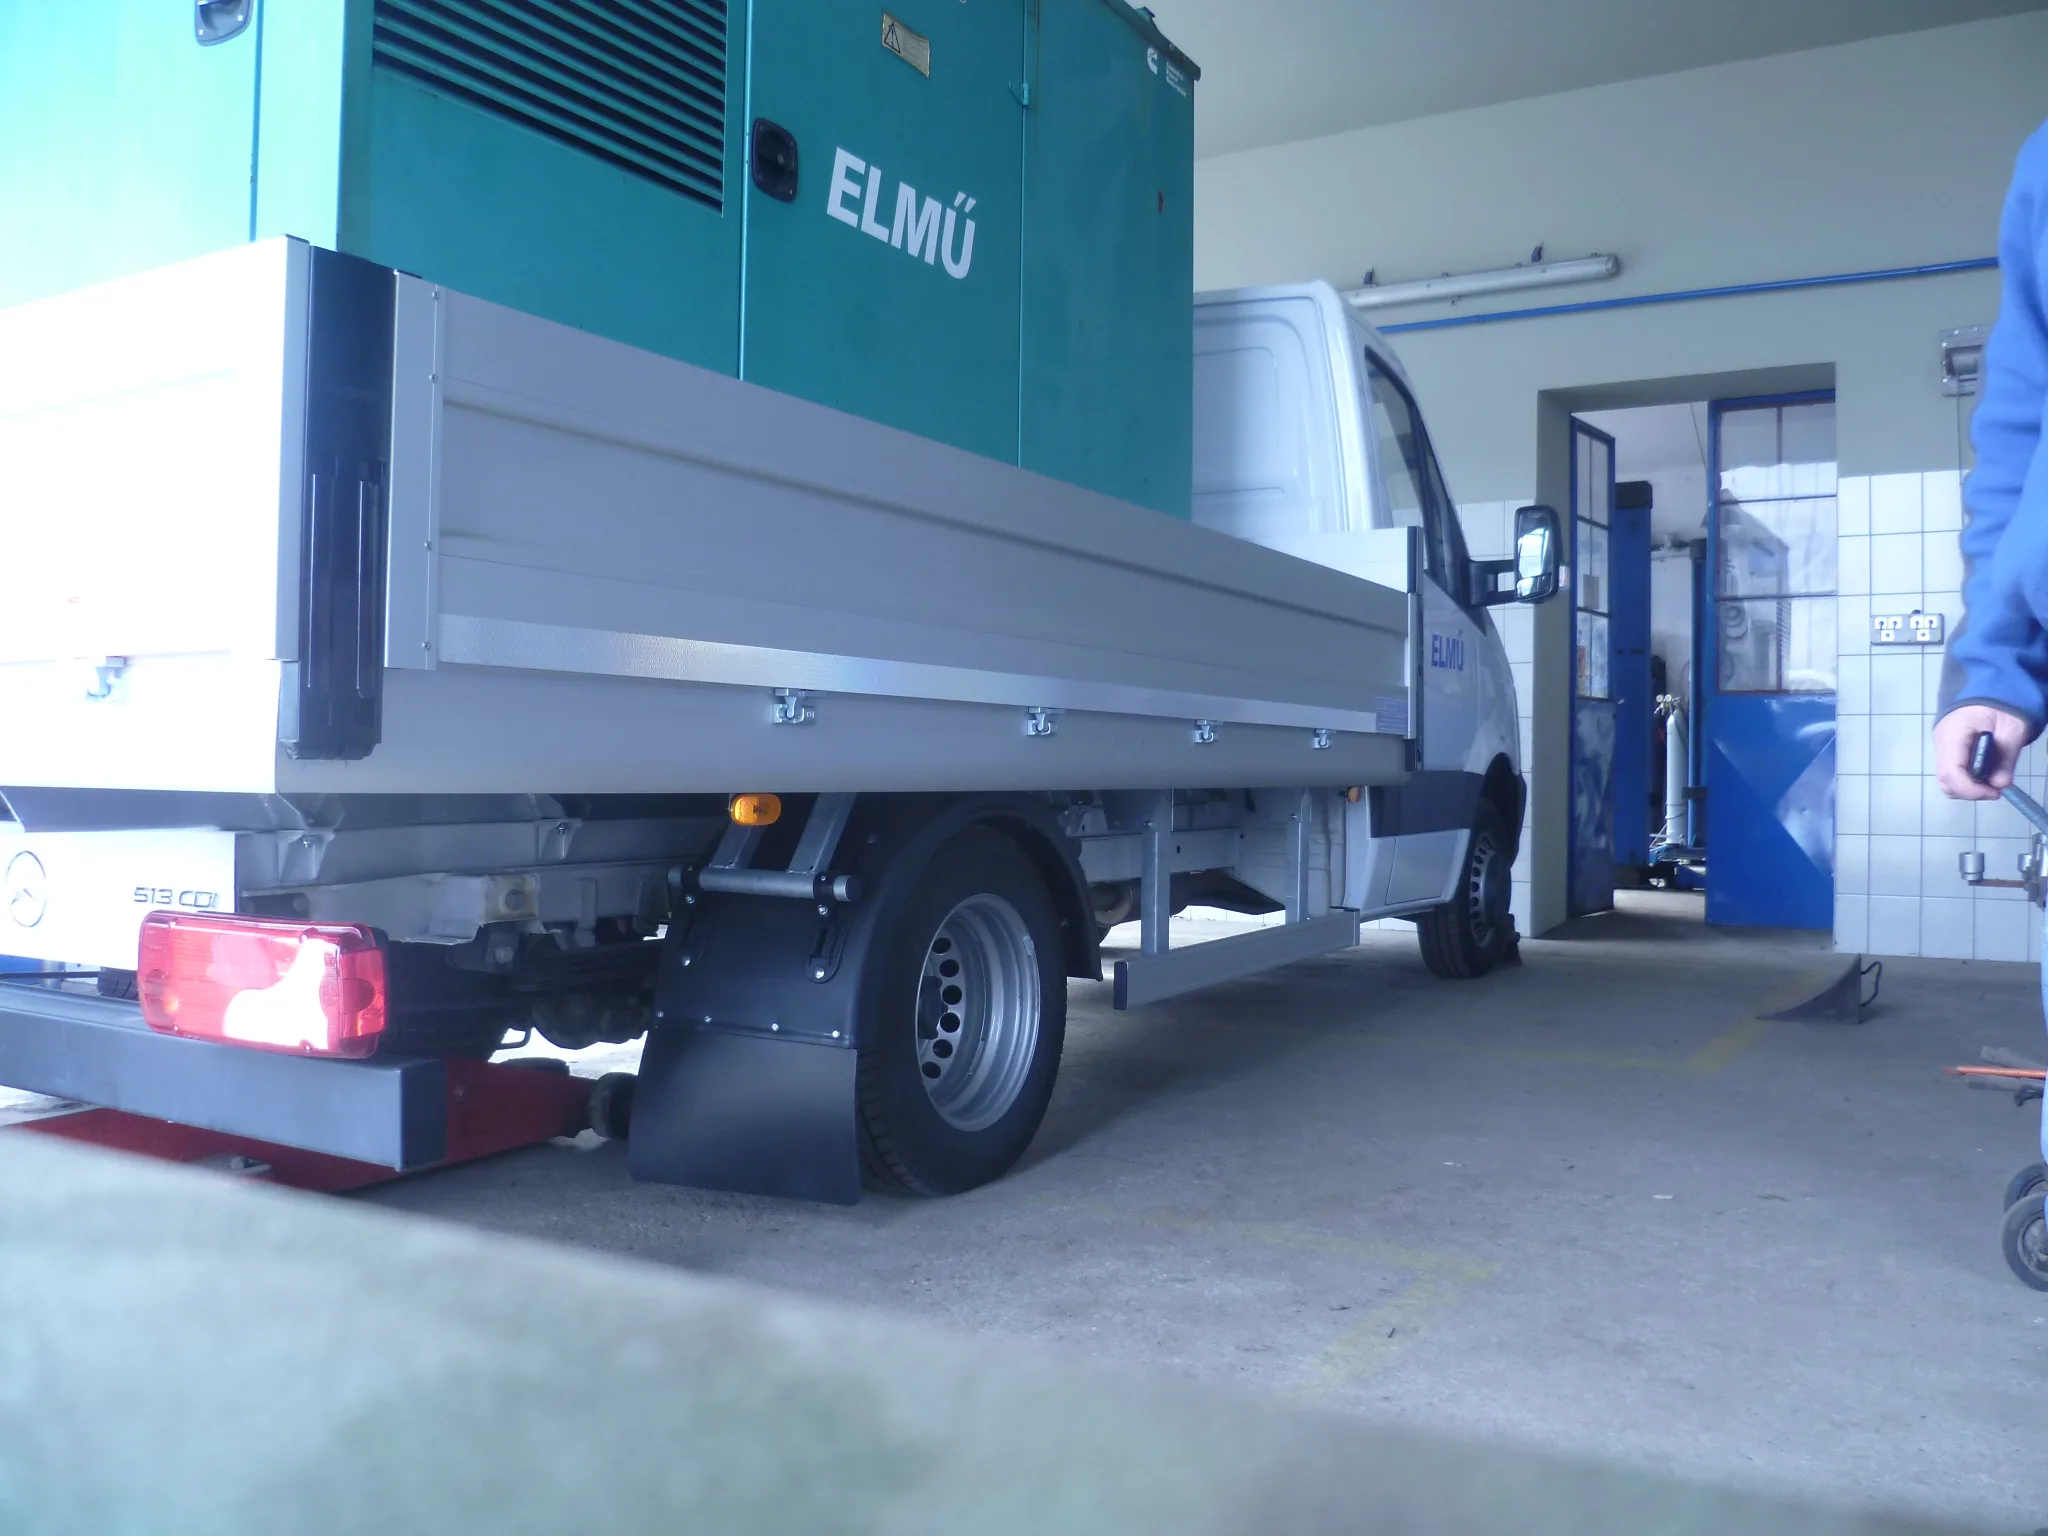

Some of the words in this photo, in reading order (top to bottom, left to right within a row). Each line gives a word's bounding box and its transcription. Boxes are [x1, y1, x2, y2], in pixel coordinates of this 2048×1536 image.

[827, 147, 976, 279] ELMŰ
[1431, 629, 1464, 671] ELMŰ
[133, 886, 173, 904] 513
